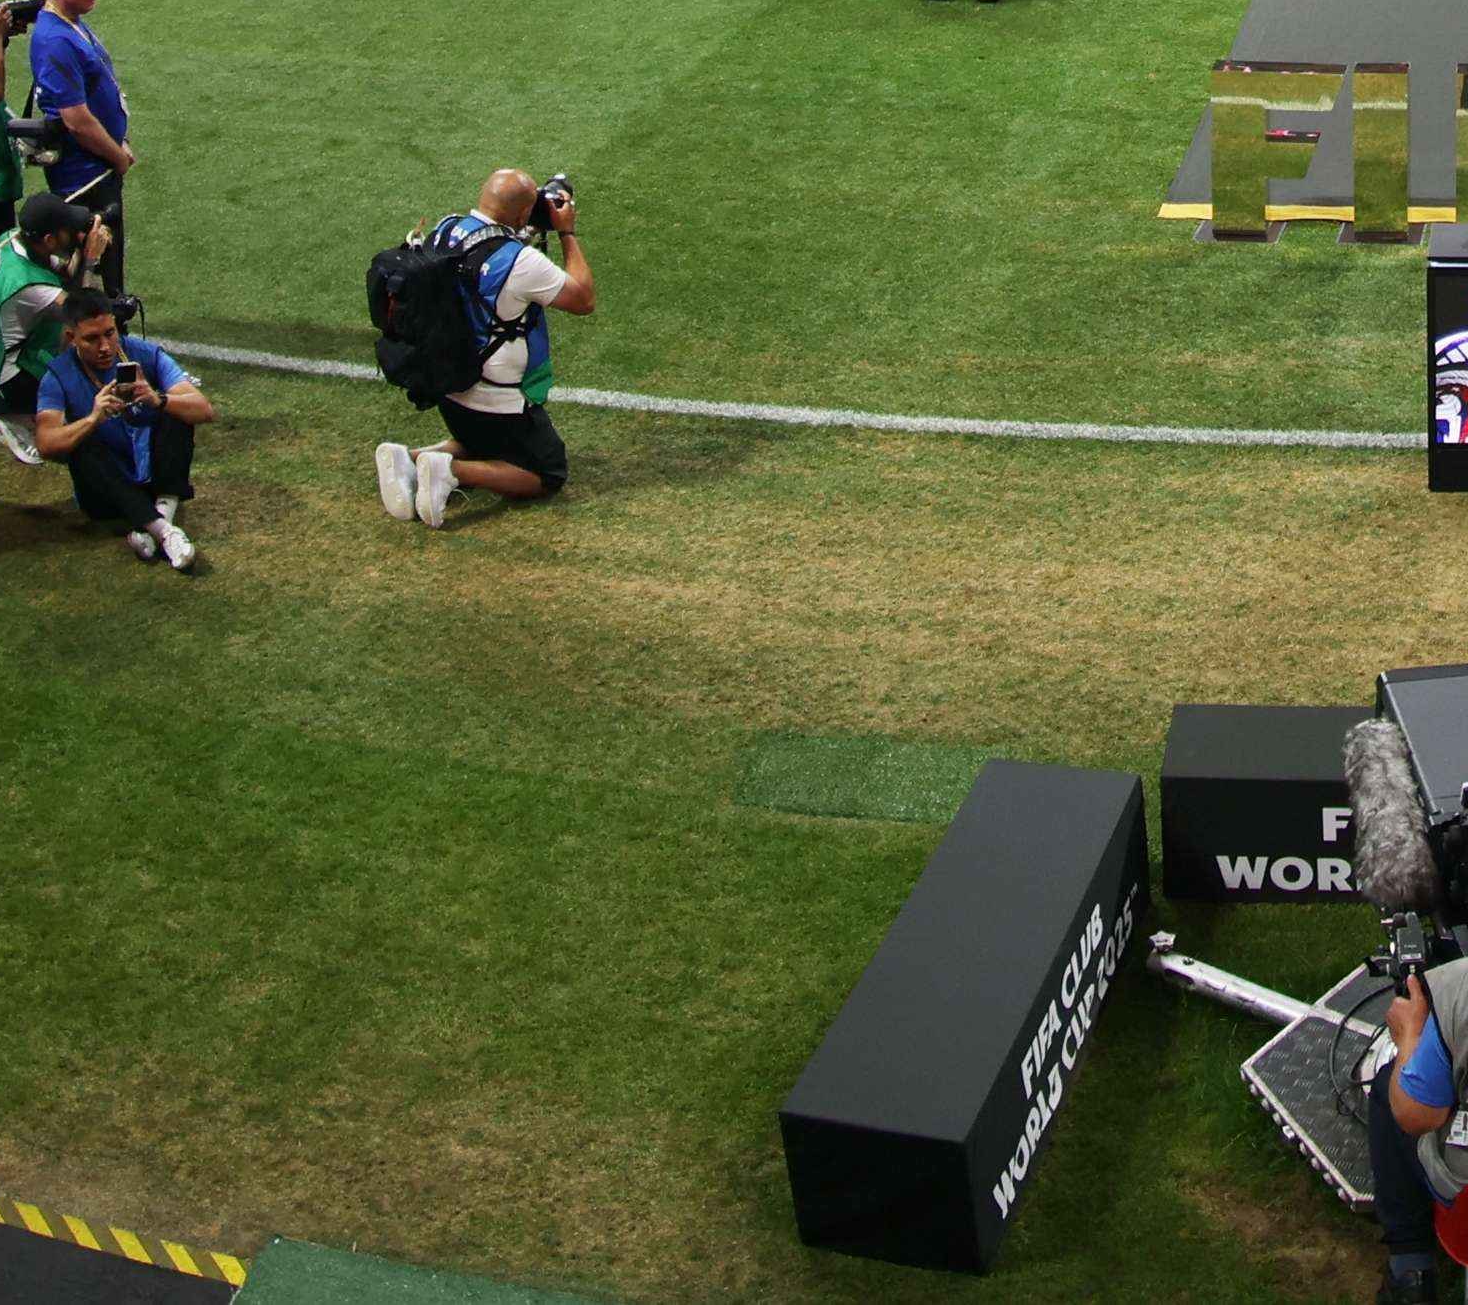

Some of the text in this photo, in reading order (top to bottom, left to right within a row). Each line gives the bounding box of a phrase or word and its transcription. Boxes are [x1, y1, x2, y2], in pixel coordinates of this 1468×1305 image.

[993, 1062, 1063, 1219] WORLD
[1062, 983, 1095, 1071] CUP
[1021, 903, 1104, 1100] FIFA CLUB
